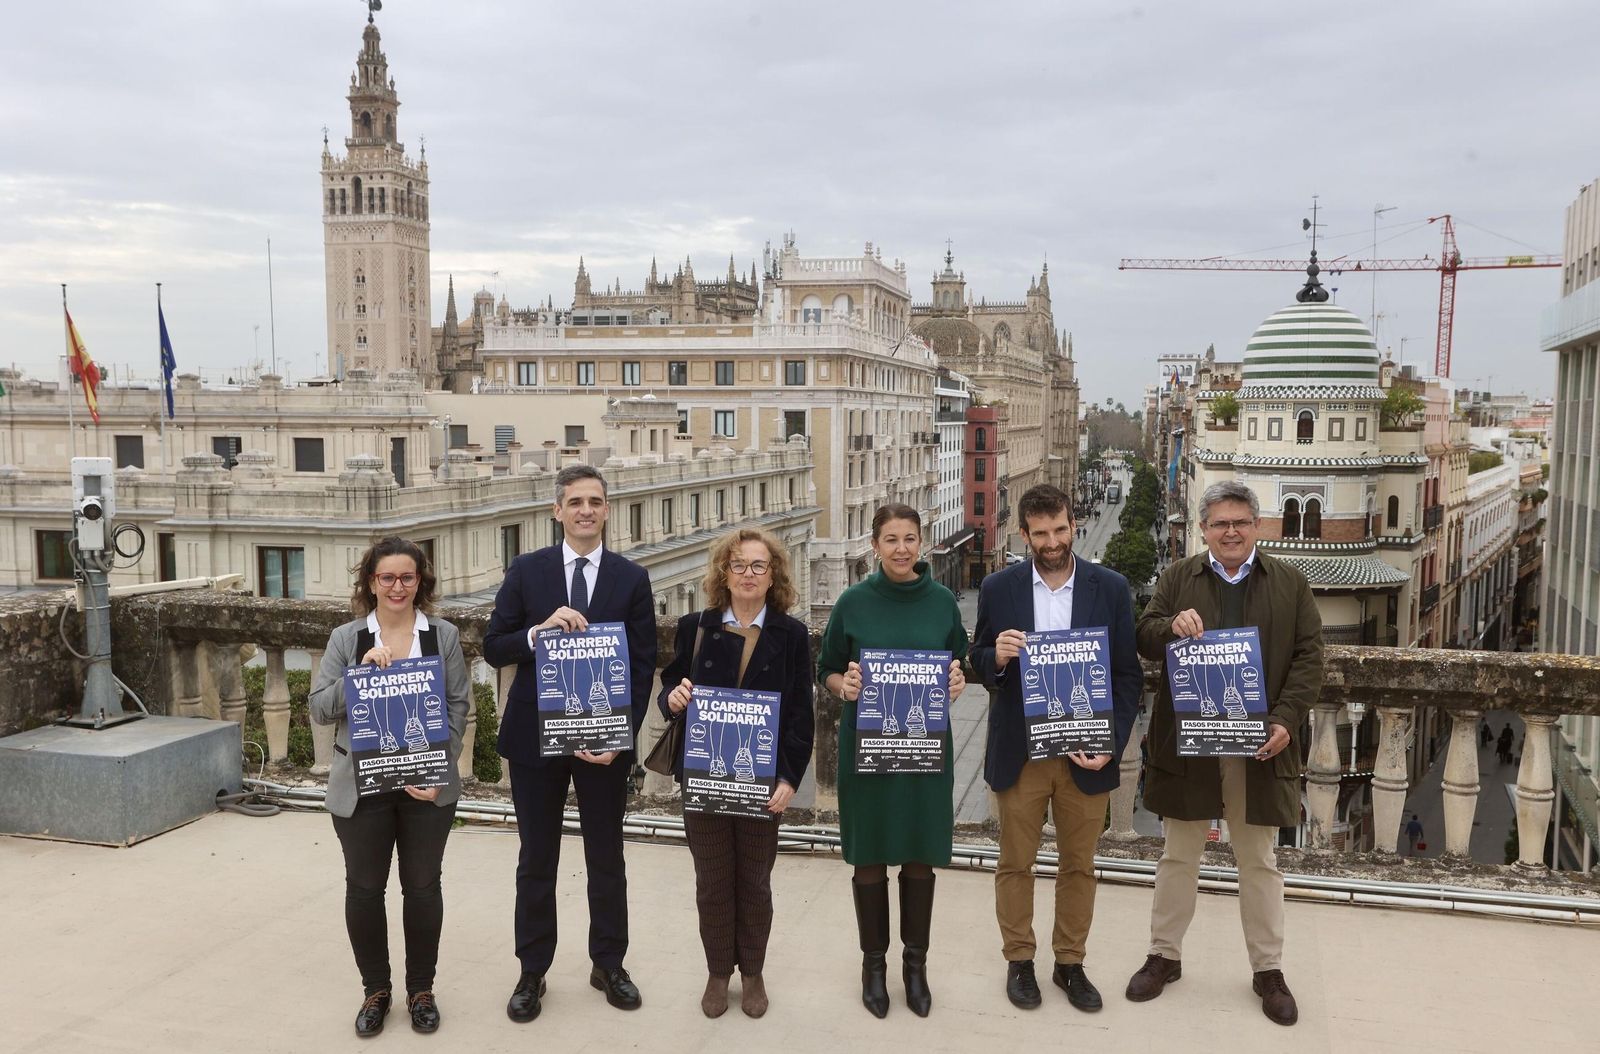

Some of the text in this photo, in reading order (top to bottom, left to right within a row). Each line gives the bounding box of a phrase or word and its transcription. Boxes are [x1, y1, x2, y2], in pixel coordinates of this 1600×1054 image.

[544, 636, 620, 650] VI CARRERA
[1026, 641, 1101, 655] VI CARRERA
[1174, 648, 1186, 658] VI
[1189, 642, 1252, 655] CARRERA
[549, 647, 616, 660] SOLIDARIA
[1030, 652, 1097, 666] SOLIDARIA
[1179, 654, 1248, 666] SOLIDARIA
[868, 663, 942, 674] VI CARRERA
[353, 670, 435, 689] VI CARRERA
[872, 674, 938, 685] SOLIDARIA
[359, 683, 431, 700] SOLIDARIA
[696, 699, 771, 715] VI CARRERA
[699, 710, 766, 726] SOLIDARIA
[413, 752, 443, 761] AUTISMO
